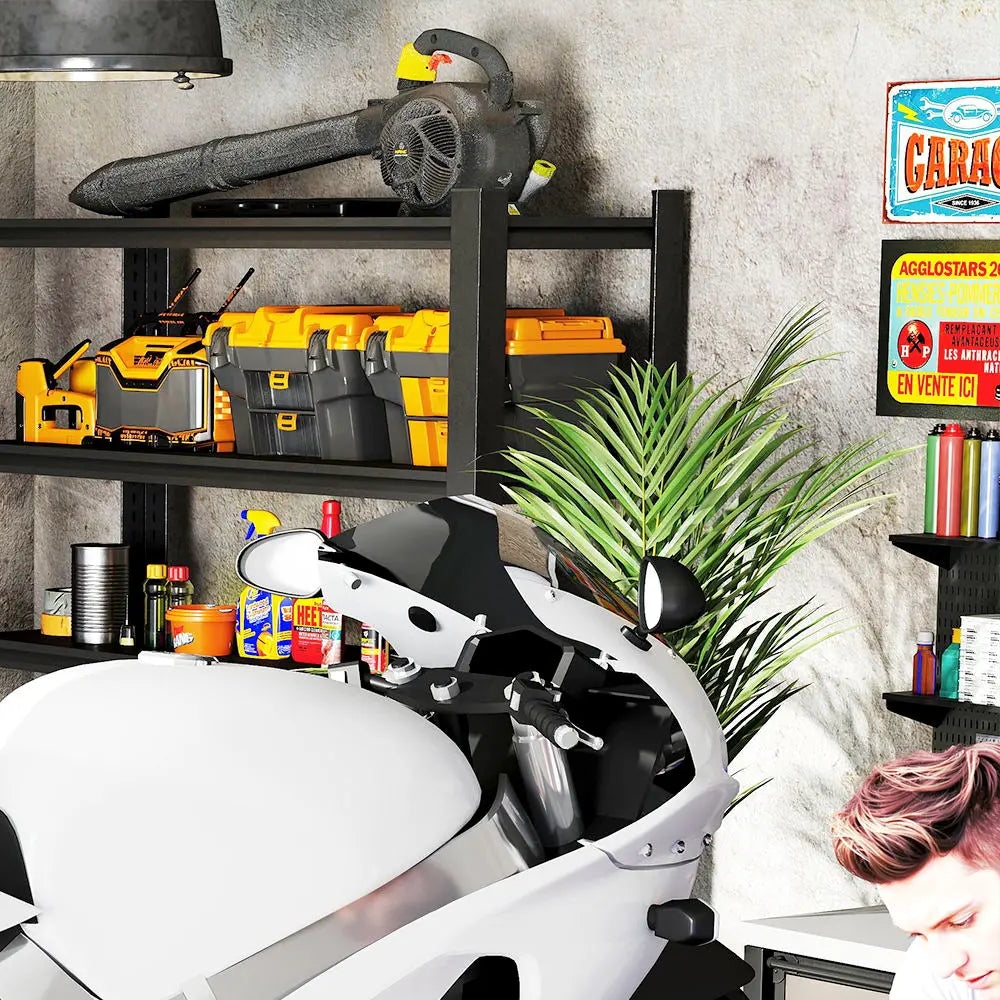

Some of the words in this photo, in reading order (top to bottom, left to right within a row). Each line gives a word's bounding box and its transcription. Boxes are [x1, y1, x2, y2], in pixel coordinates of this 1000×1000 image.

[899, 260, 987, 277] AGGLOSTARS
[989, 260, 1000, 277] 2
[901, 345, 910, 358] H
[922, 345, 931, 358] P
[944, 348, 958, 361] LES
[983, 361, 1000, 374] NAT
[898, 373, 913, 395] EN
[917, 374, 956, 397] VENTE
[959, 376, 975, 398] ICI
